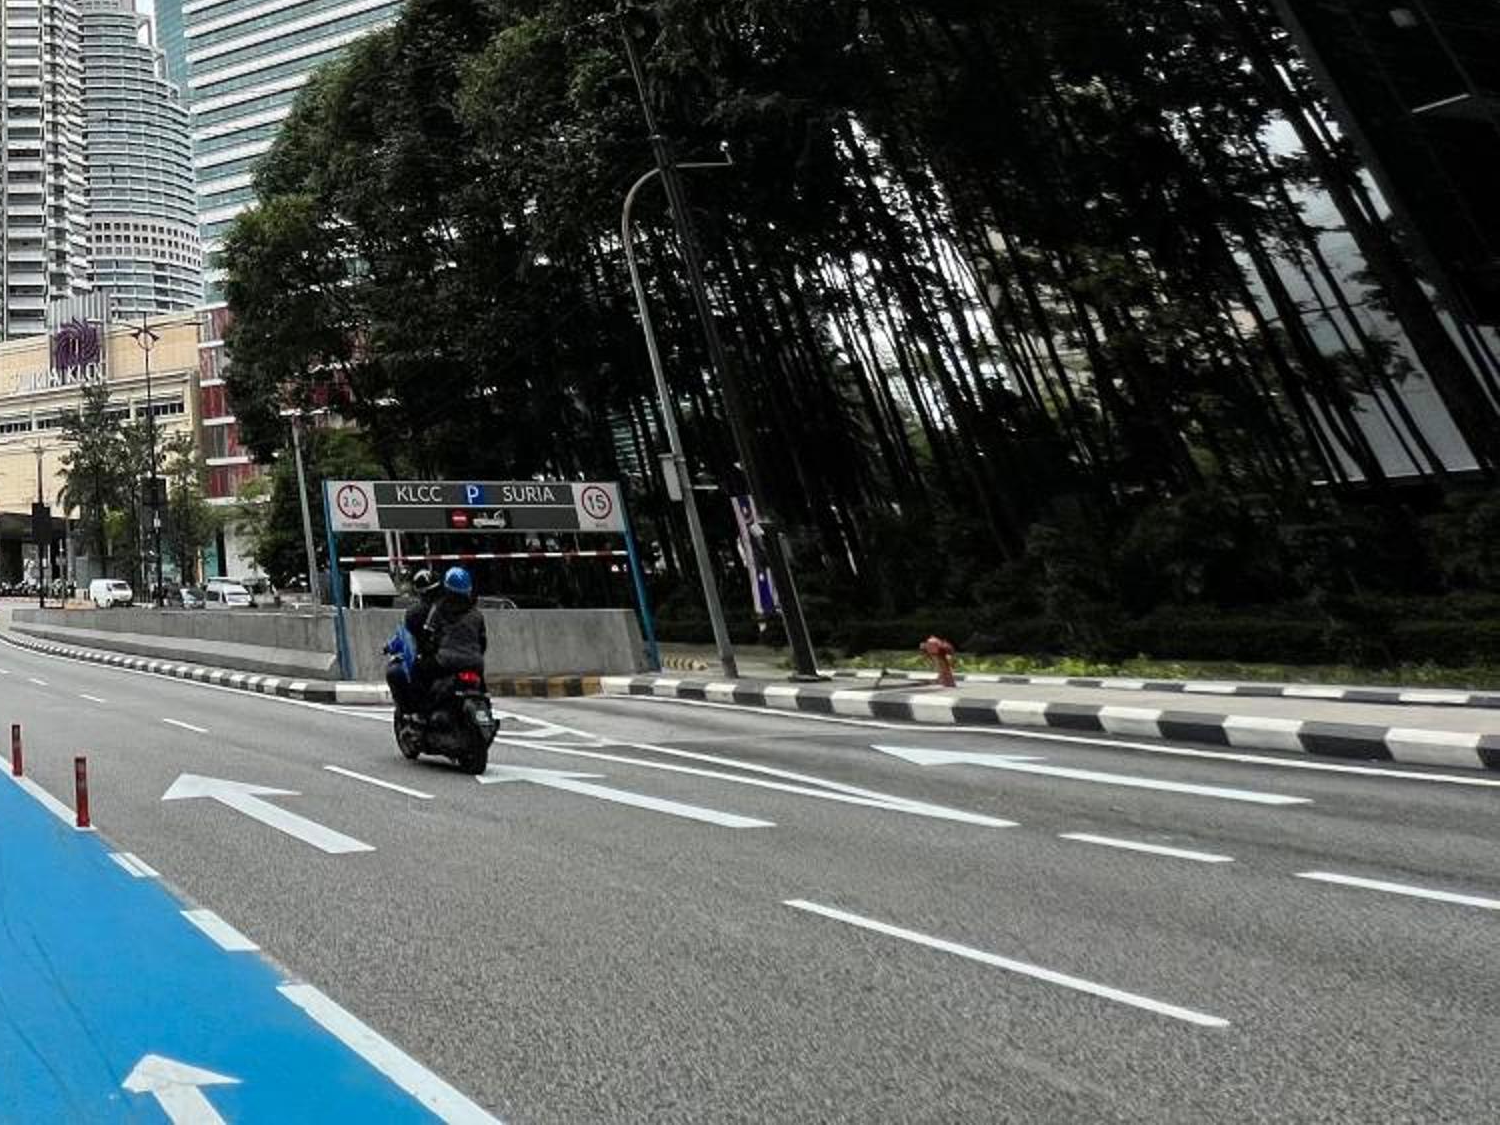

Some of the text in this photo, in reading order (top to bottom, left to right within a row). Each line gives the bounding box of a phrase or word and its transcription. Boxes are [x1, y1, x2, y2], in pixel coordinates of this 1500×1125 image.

[395, 485, 556, 504] KLCC P SURIA
[587, 494, 607, 510] 15
